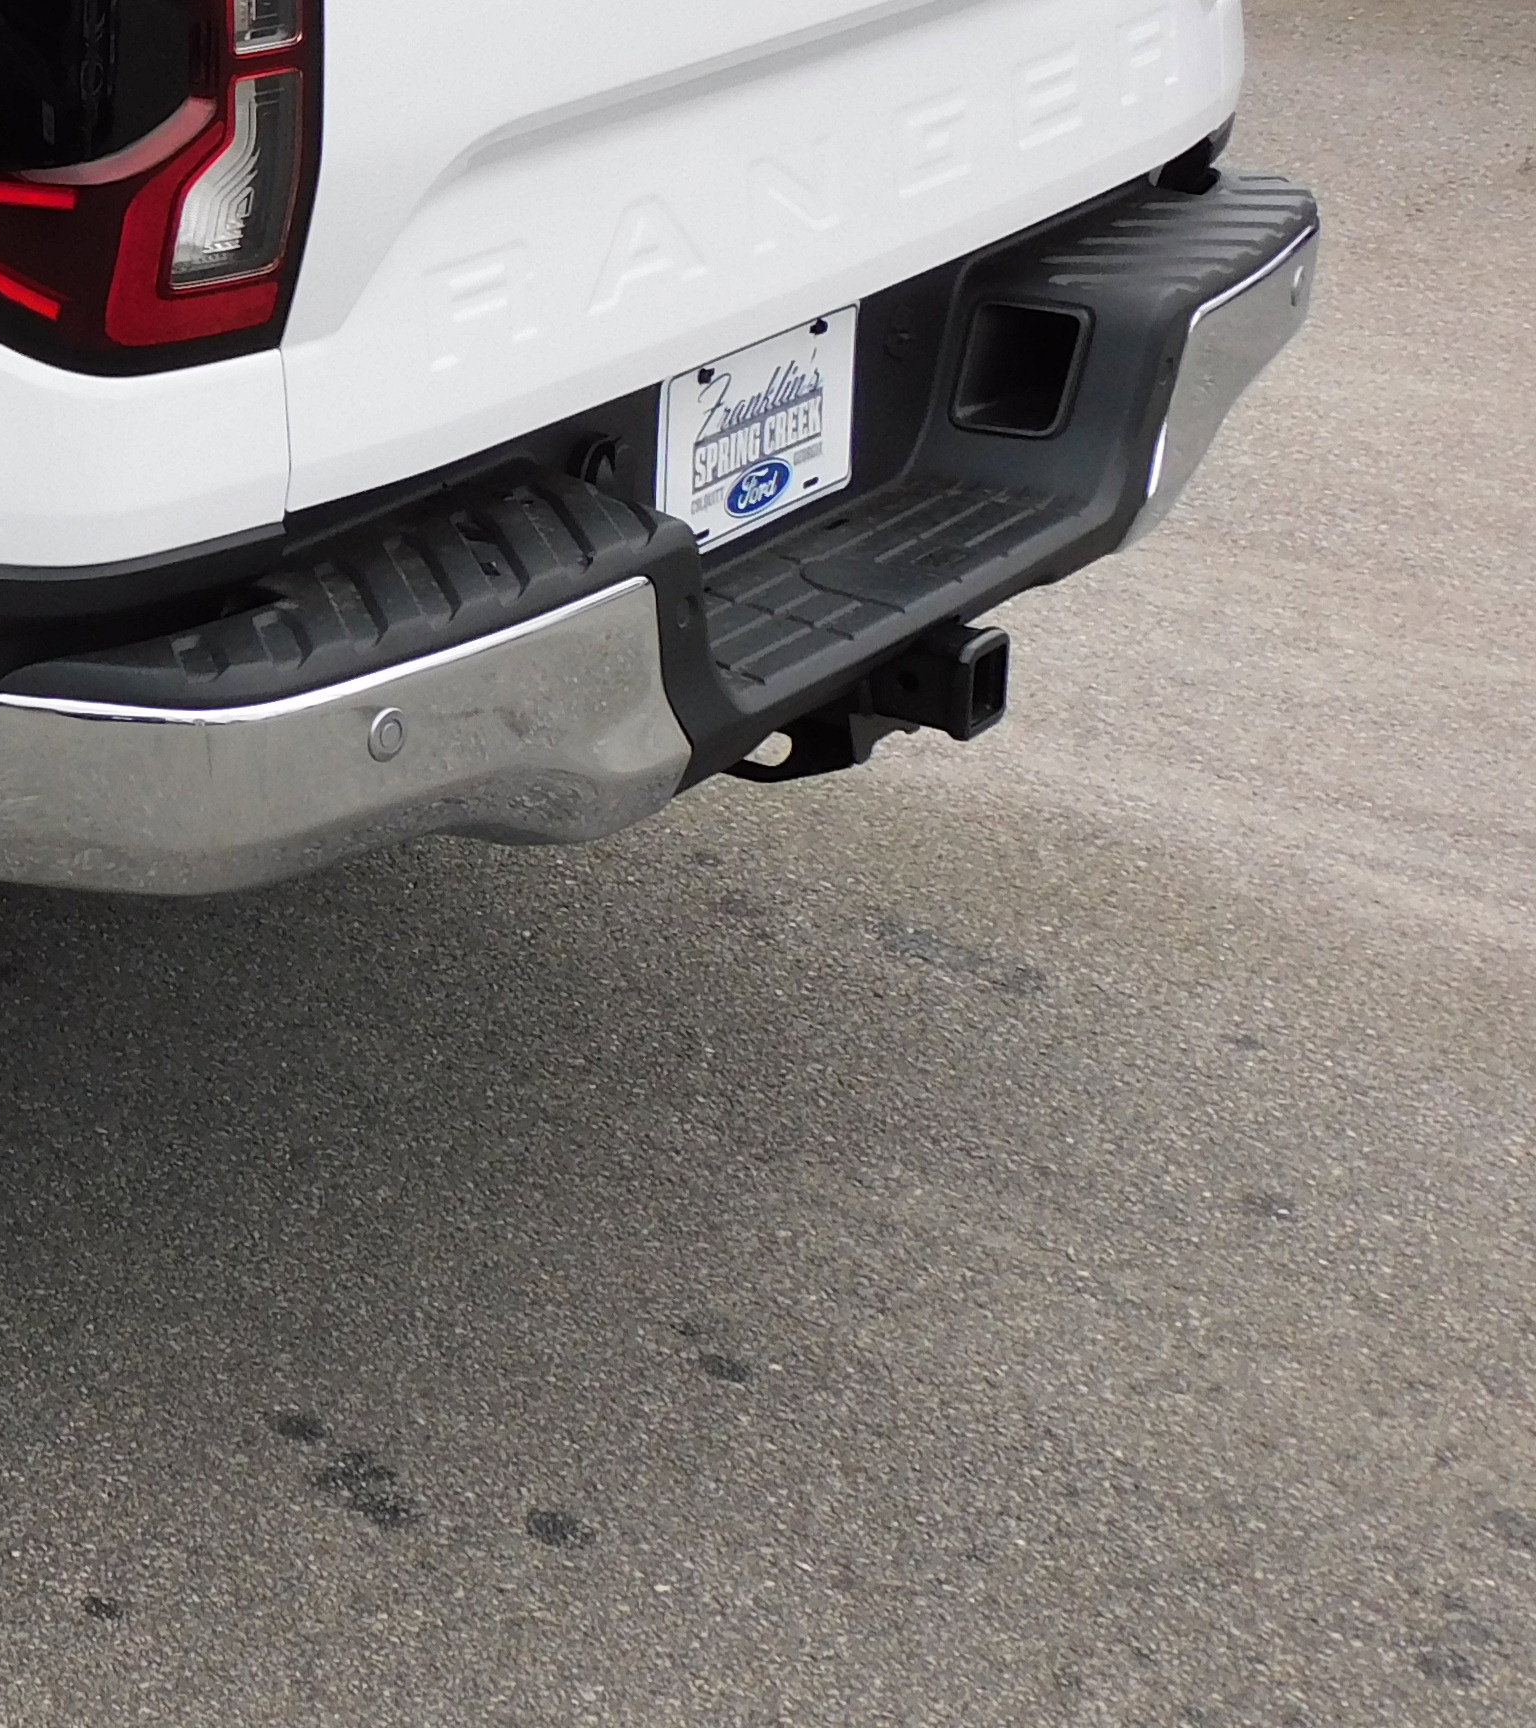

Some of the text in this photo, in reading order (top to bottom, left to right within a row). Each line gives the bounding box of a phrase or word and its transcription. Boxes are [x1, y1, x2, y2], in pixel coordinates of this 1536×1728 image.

[422, 6, 1180, 374] RANGER
[695, 346, 822, 441] Franklin's
[694, 395, 822, 490] SPRING CREEK
[736, 467, 779, 511] Ford
